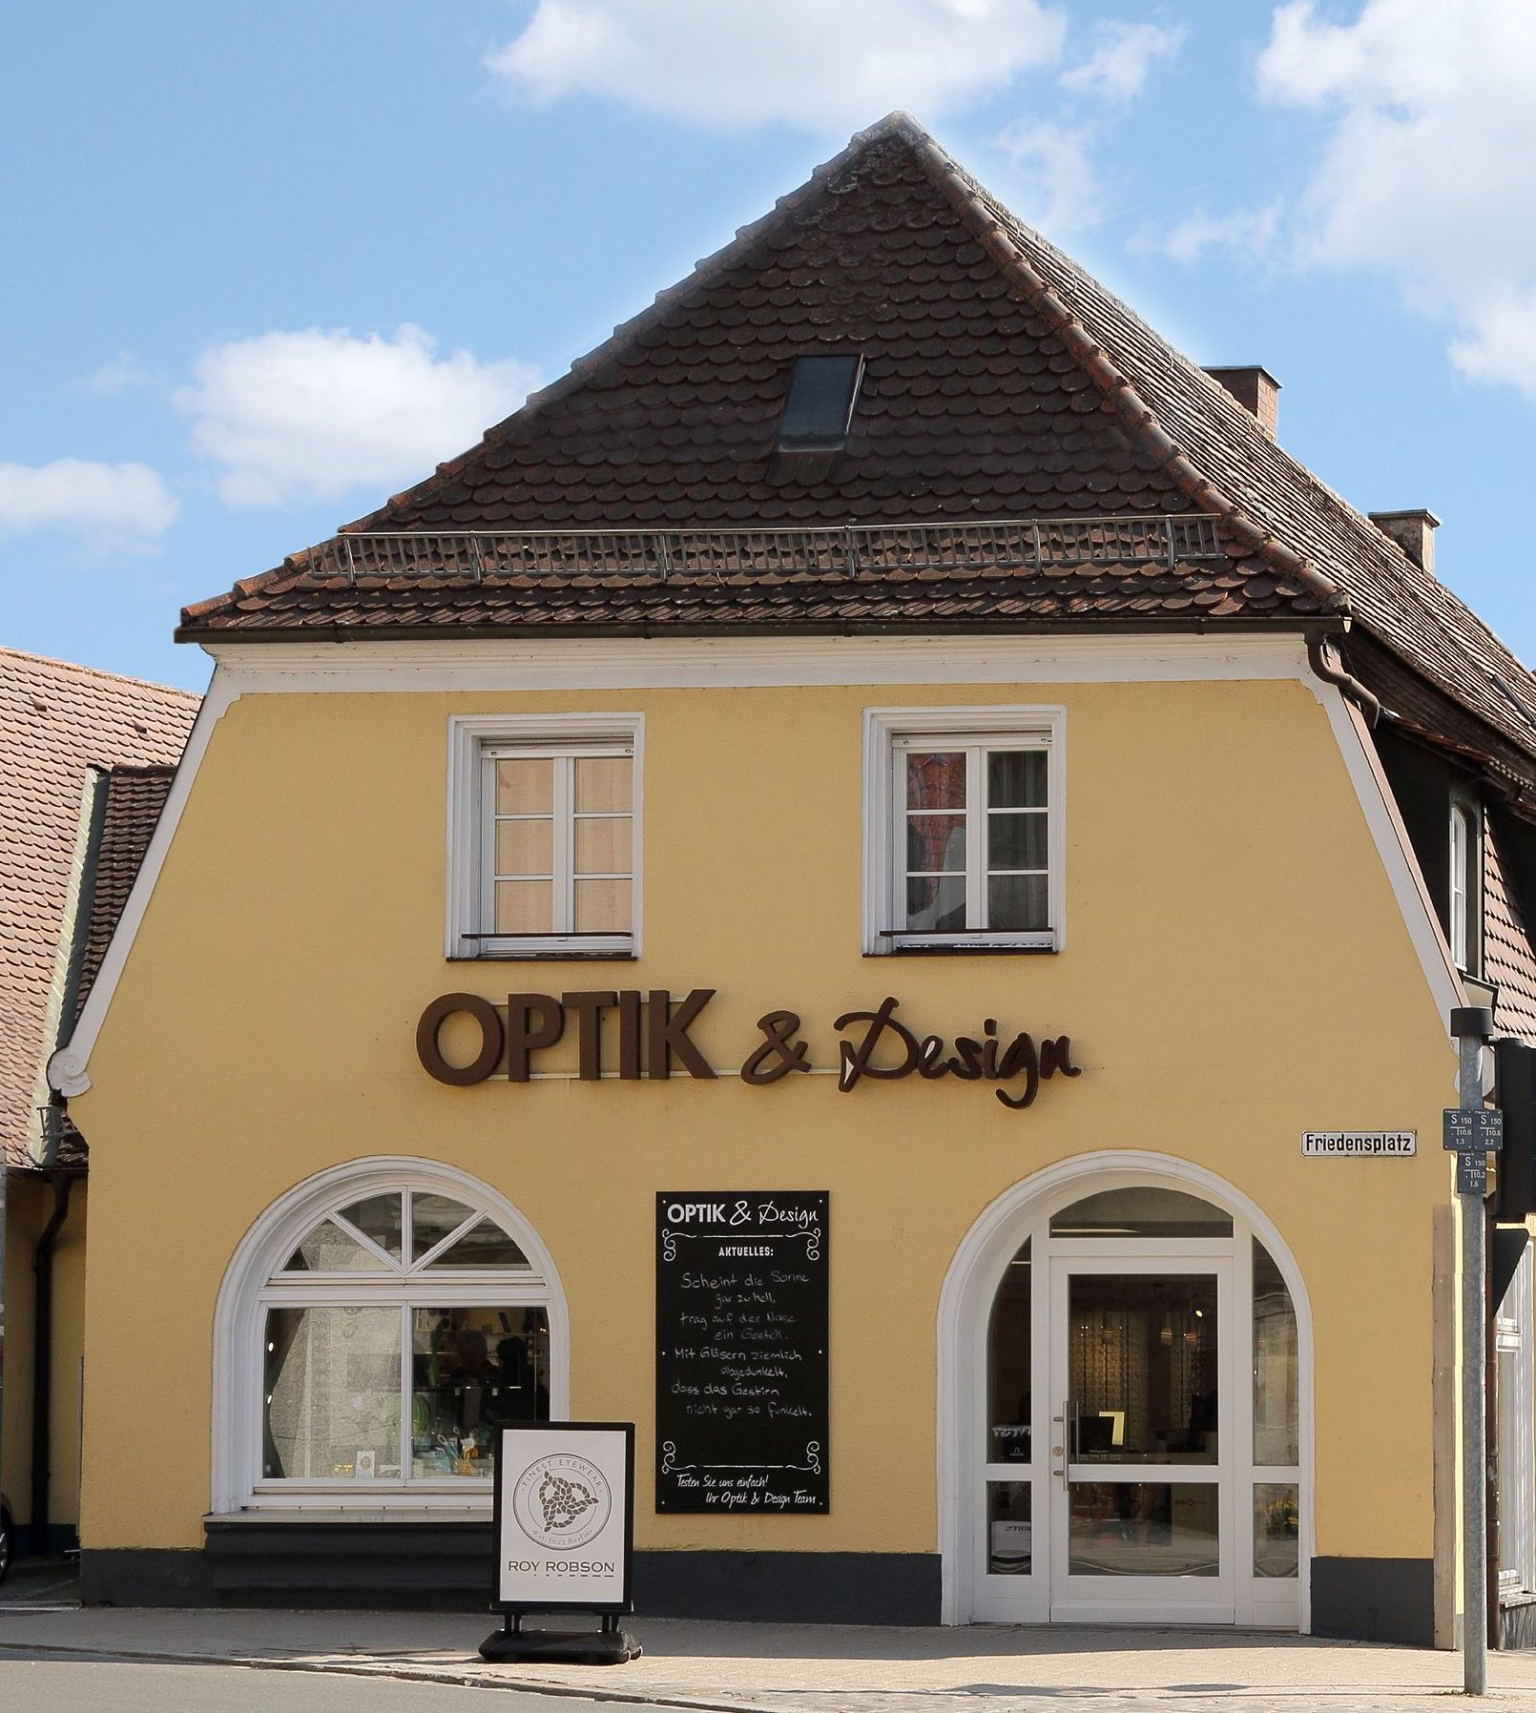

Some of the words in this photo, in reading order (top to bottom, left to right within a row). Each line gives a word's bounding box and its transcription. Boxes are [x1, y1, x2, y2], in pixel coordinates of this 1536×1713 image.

[416, 988, 718, 1086] OPTIK
[740, 1009, 811, 1085] &
[834, 996, 1081, 1109] Design
[1451, 1114, 1457, 1124] S
[1481, 1114, 1487, 1125] S
[1306, 1134, 1411, 1153] Friedensplatz
[1465, 1157, 1471, 1166] S
[667, 1203, 726, 1223] OPTIK
[729, 1200, 752, 1226] &
[758, 1200, 819, 1229] Design
[718, 1246, 774, 1257] AKTUELLES:
[680, 1272, 738, 1289] Scheint
[744, 1273, 765, 1287] die
[770, 1270, 810, 1283] Sonne
[739, 1312, 761, 1323] der
[714, 1330, 734, 1341] ein
[675, 1348, 696, 1359] Mit
[700, 1346, 746, 1361] Gläsern
[751, 1350, 803, 1361] ziemlich
[703, 1383, 728, 1396] das
[686, 1404, 718, 1415] nicht
[522, 1461, 552, 1487] FINEST
[559, 1459, 603, 1488] EYEWEAR
[677, 1473, 700, 1487] Testen
[702, 1474, 717, 1487] Sie
[719, 1478, 734, 1487] uns
[705, 1491, 721, 1504] Ihr
[721, 1491, 748, 1509] Optik
[750, 1492, 761, 1505] &
[764, 1492, 791, 1509] Design
[508, 1560, 540, 1571] ROY
[546, 1561, 614, 1573] ROBSON
